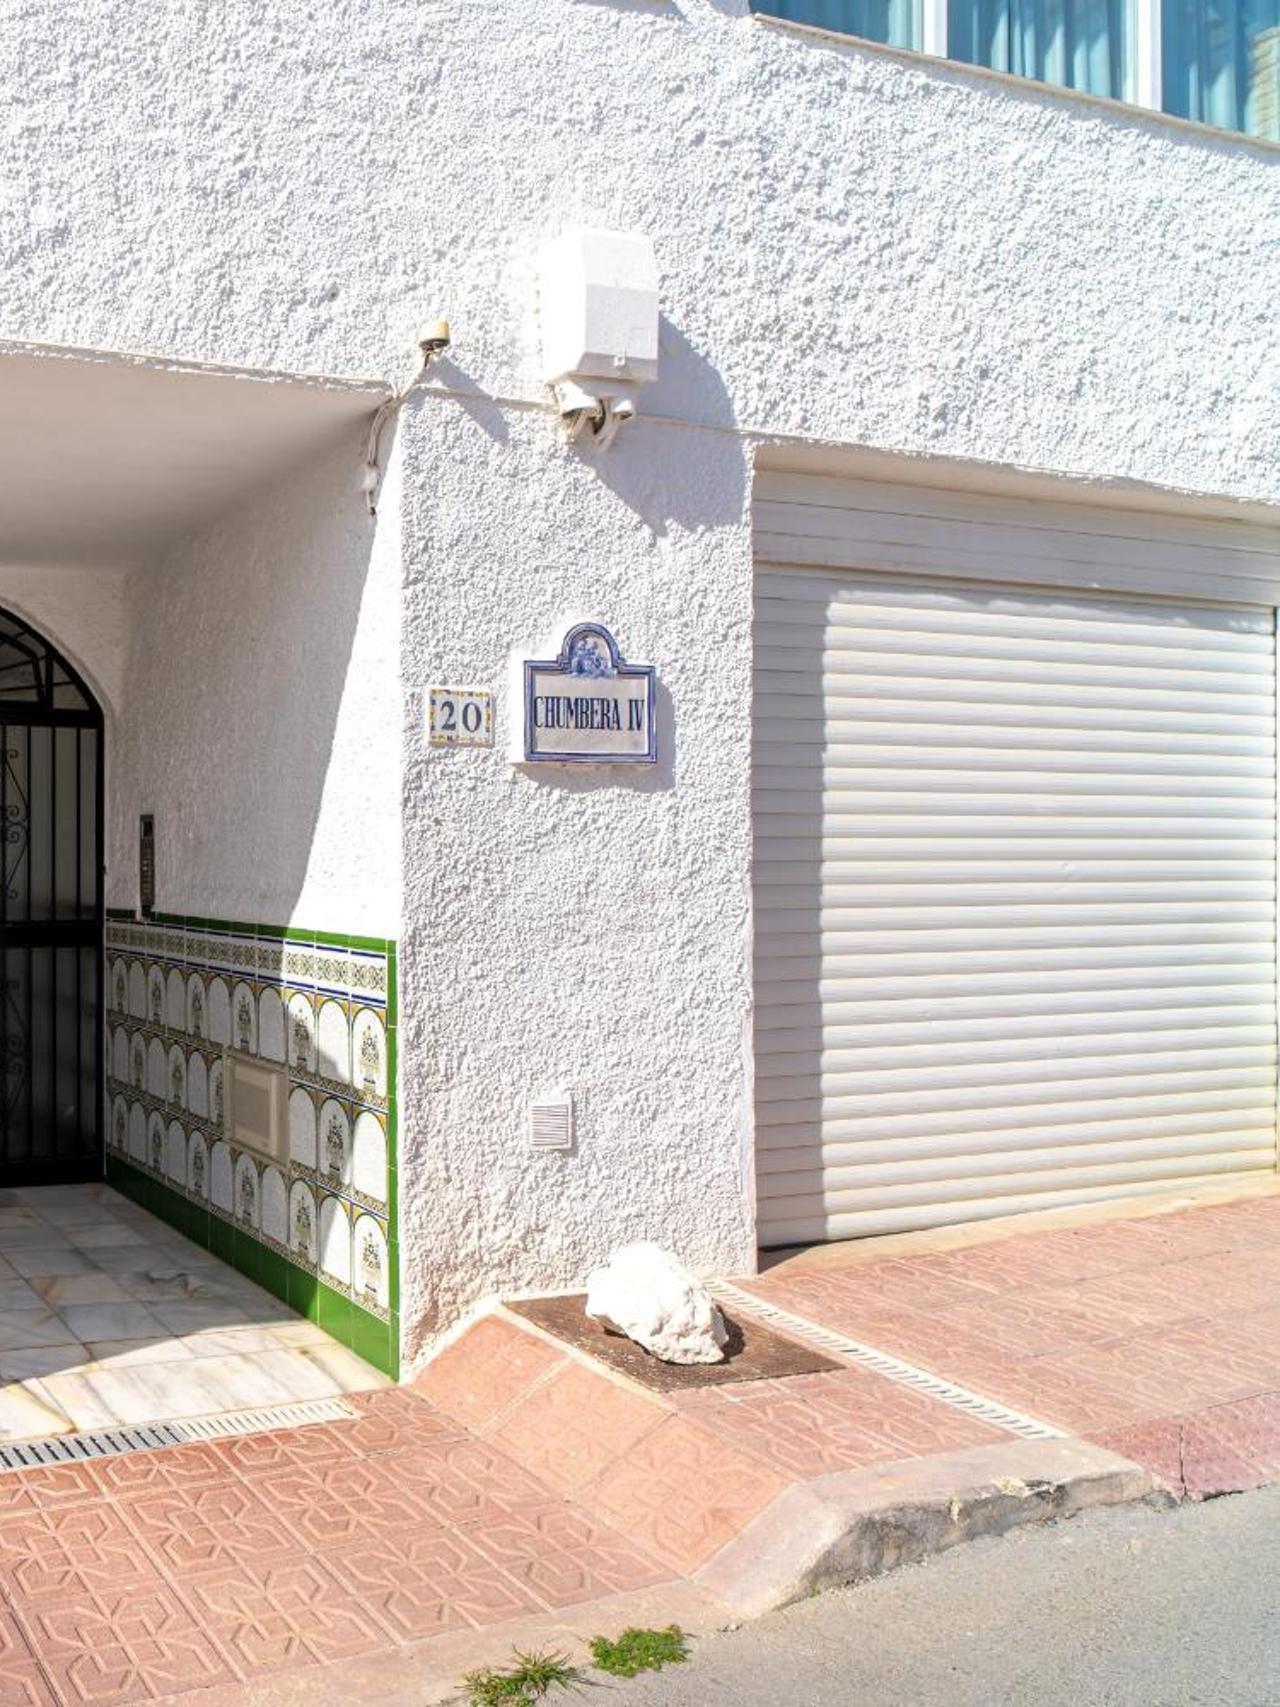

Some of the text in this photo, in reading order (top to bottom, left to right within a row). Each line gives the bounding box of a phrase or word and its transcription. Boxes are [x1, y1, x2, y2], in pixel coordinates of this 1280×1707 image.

[440, 700, 482, 733] 20
[534, 696, 645, 731] CHUMBERA IV
